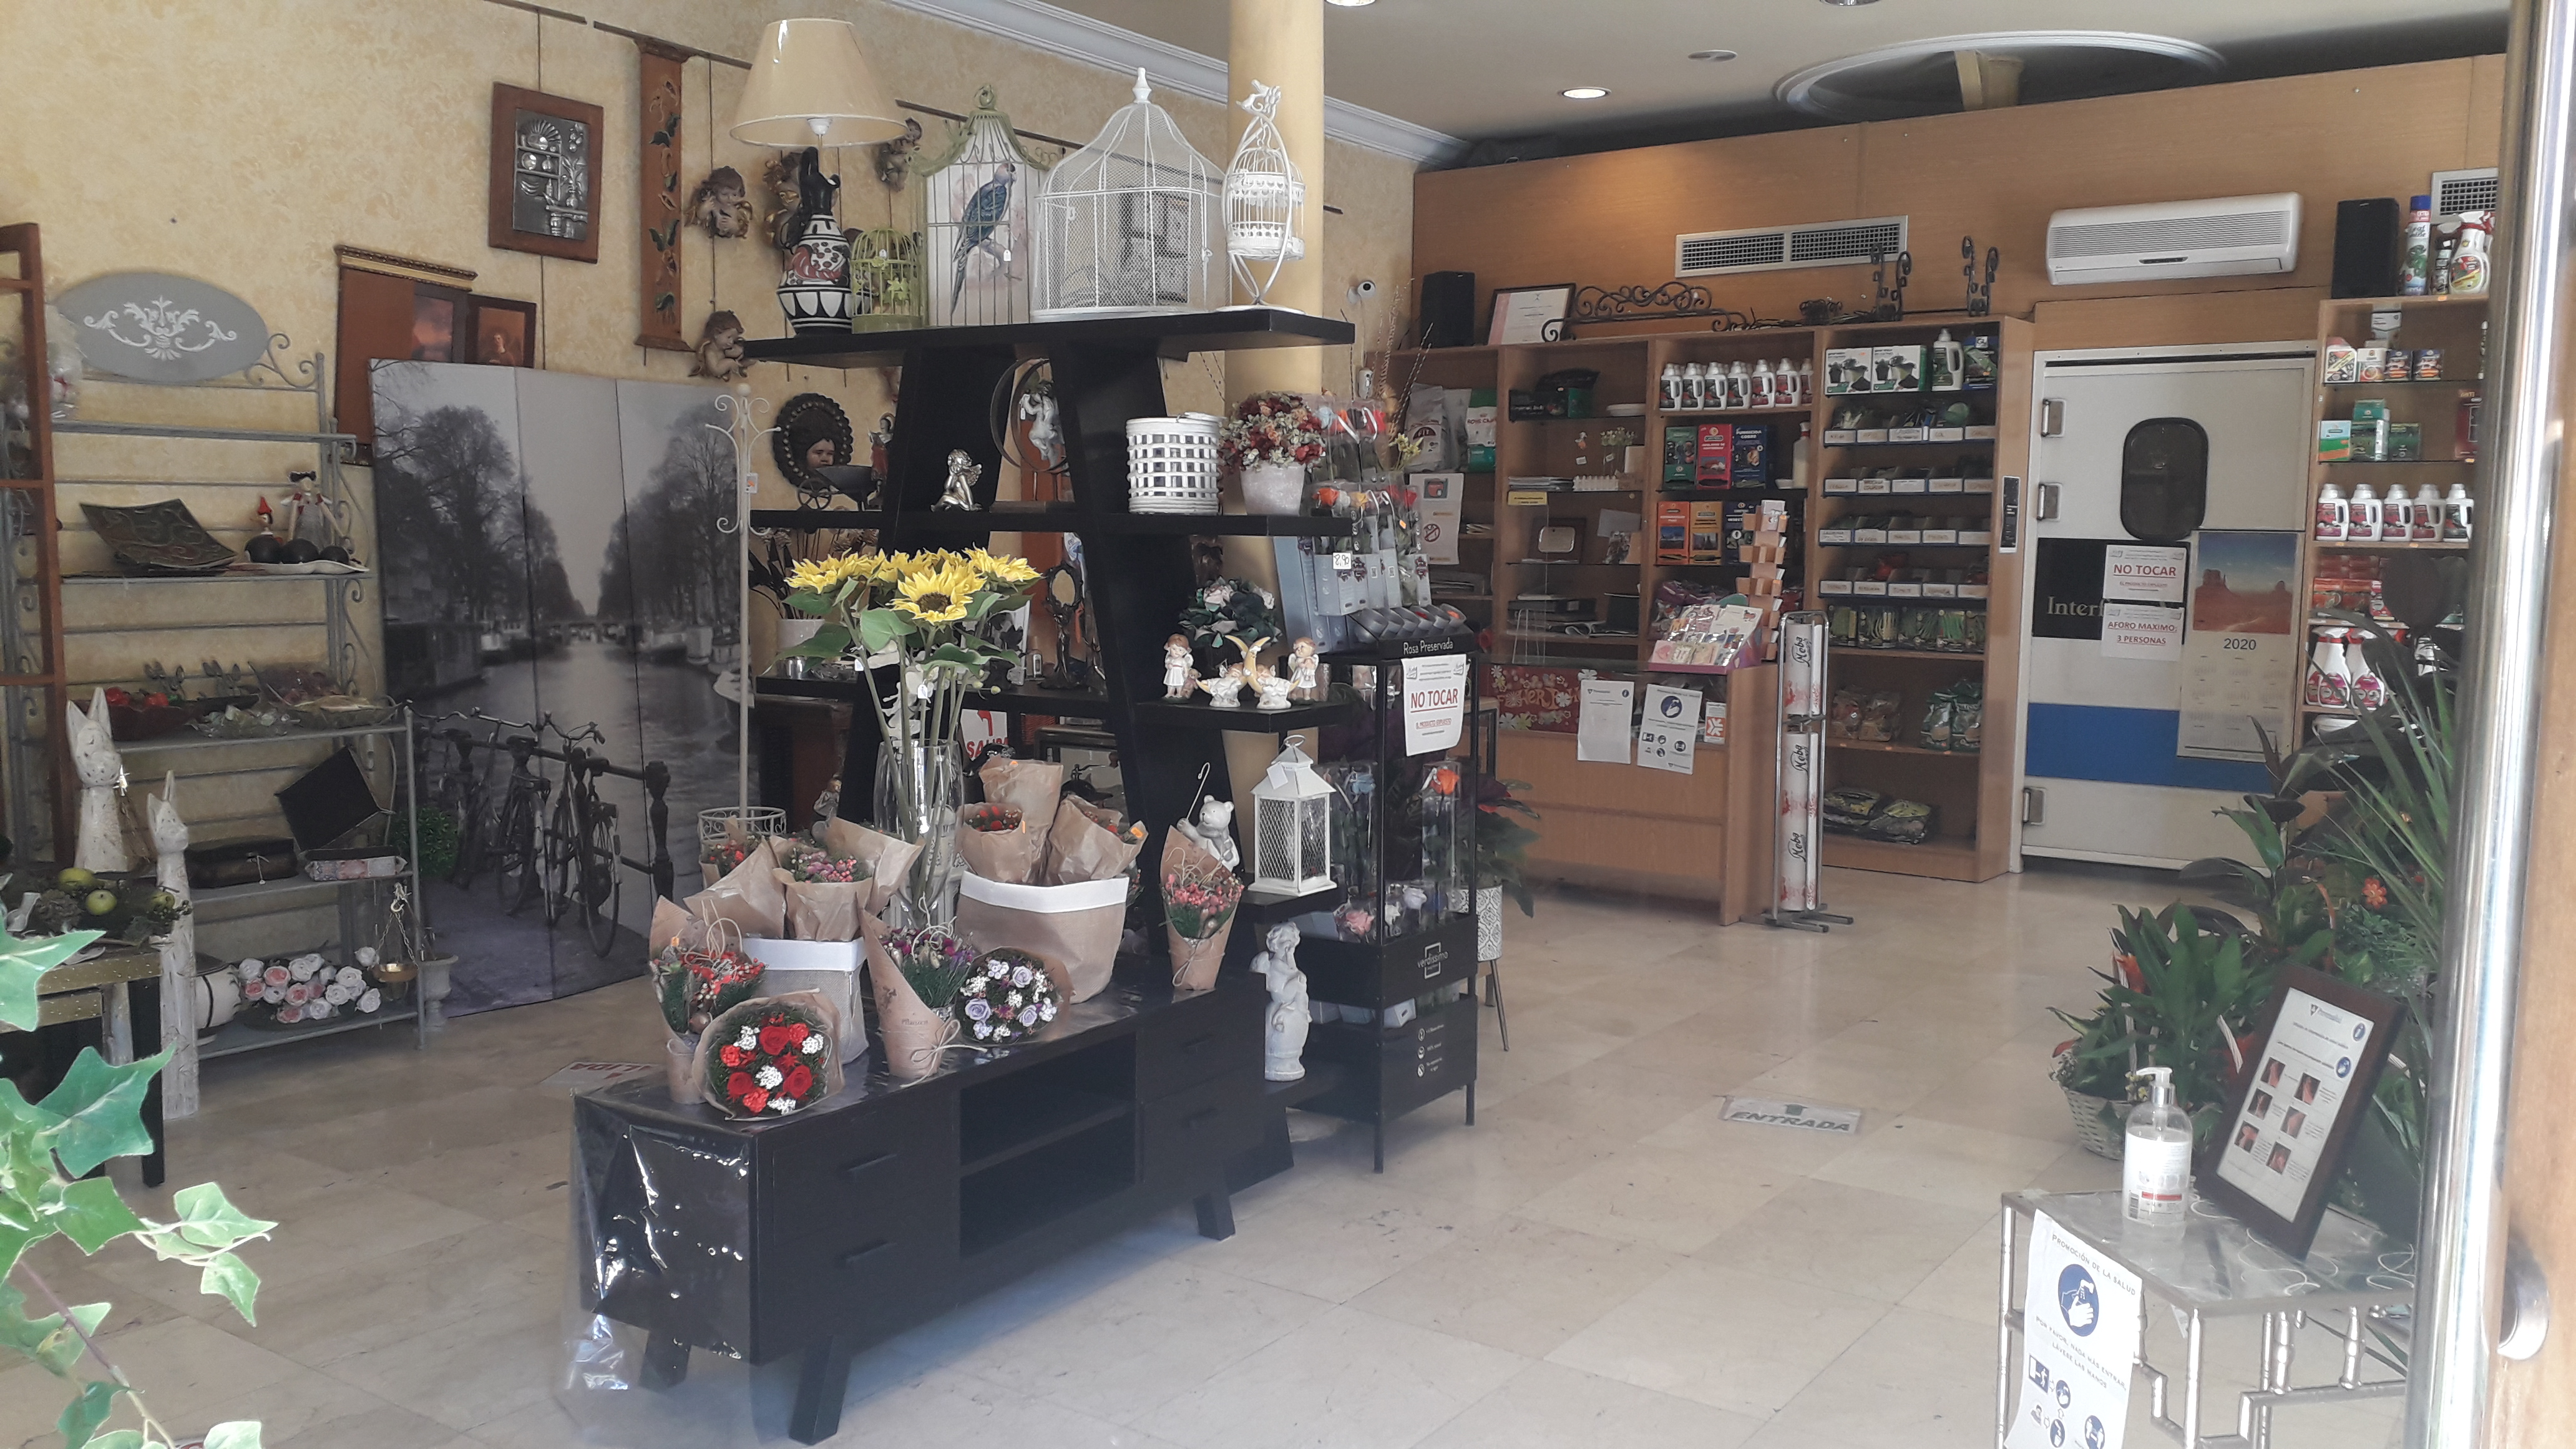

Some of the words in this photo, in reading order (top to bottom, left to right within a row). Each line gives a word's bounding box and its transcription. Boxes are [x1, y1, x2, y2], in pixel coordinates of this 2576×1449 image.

[2114, 564, 2132, 574] NO
[2135, 565, 2176, 576] TOCAR
[2107, 622, 2136, 630] AFORO
[1403, 642, 1419, 655] Rosa
[1420, 637, 1454, 653] Preservada
[2124, 636, 2167, 644] PERSONAS
[2223, 638, 2256, 650] 2020
[1410, 691, 1425, 709] NO
[1427, 688, 1458, 707] TOCAR
[1729, 1111, 1850, 1131] ENTRADA
[2092, 1262, 2100, 1273] DE
[2102, 1269, 2111, 1280] LA
[2114, 1276, 2136, 1296] SALUD
